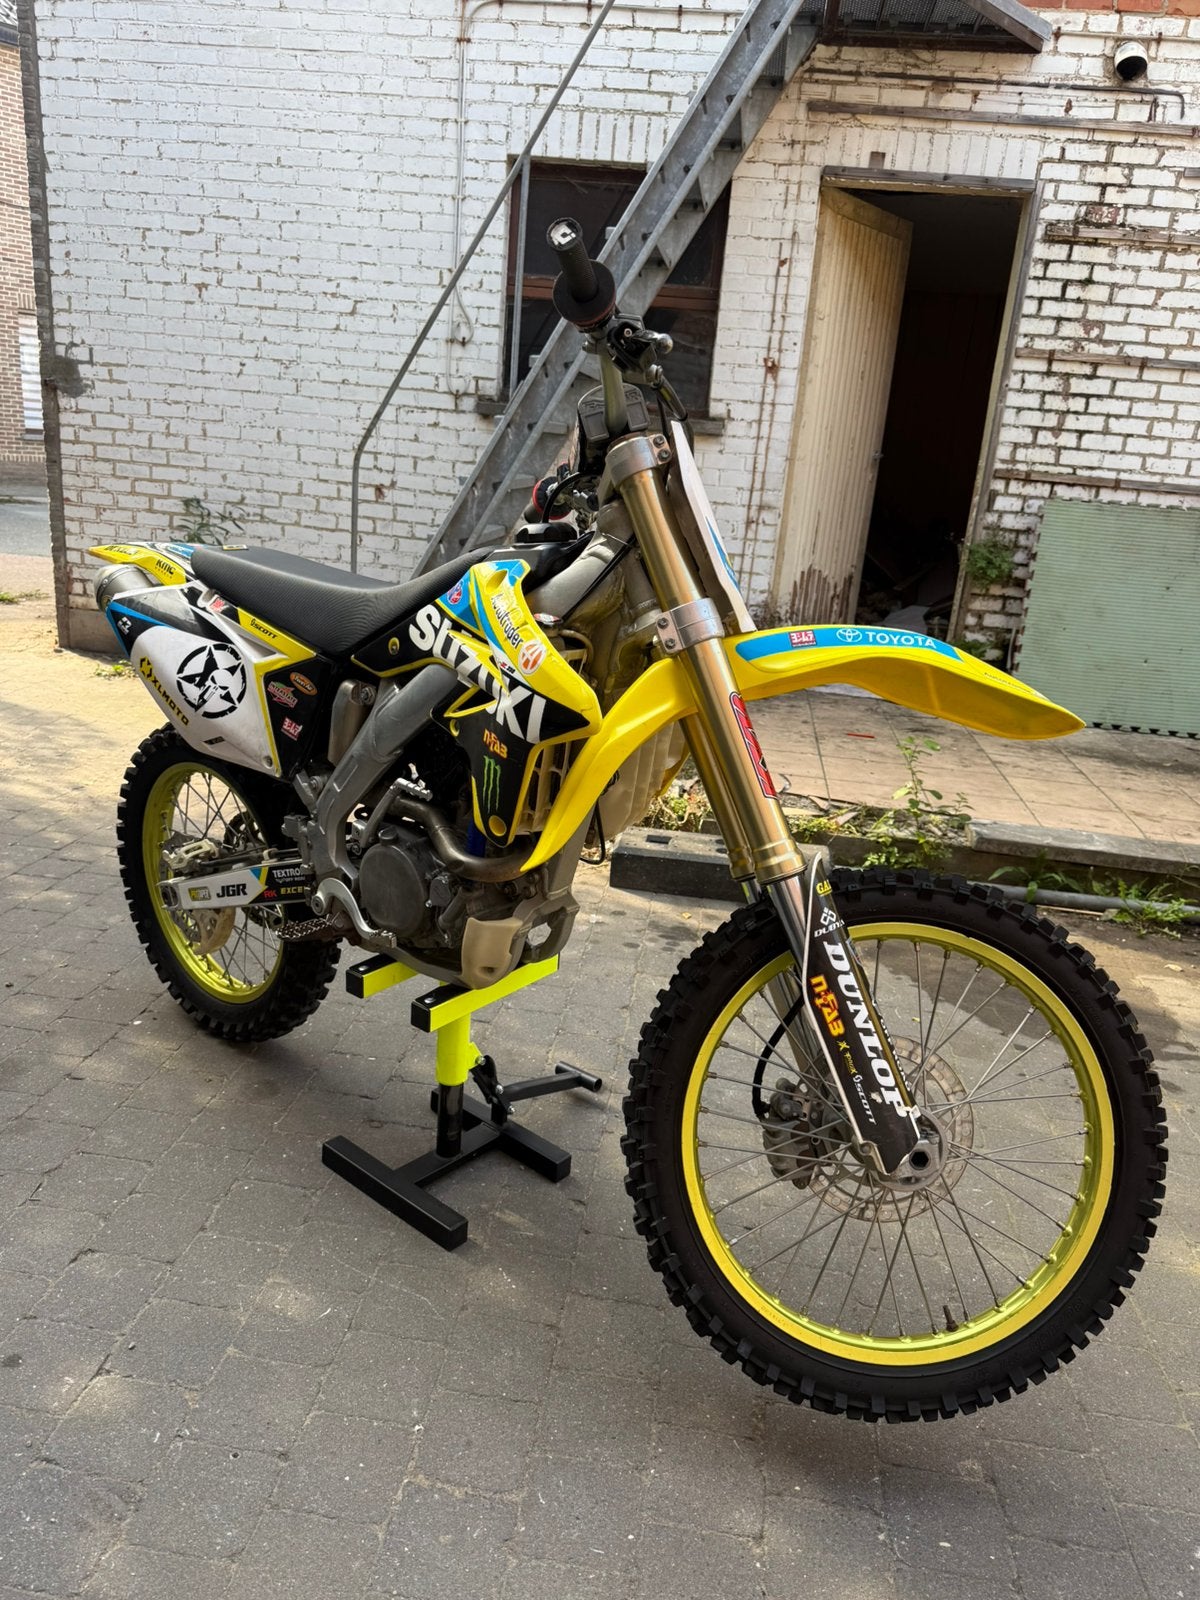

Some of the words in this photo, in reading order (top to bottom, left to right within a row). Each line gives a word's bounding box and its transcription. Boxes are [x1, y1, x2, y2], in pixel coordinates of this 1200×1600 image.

[254, 623, 278, 639] SCOTT
[865, 631, 937, 649] TOYOTA
[409, 604, 546, 744] SUZUKI
[152, 679, 190, 726] XLMOTO
[272, 867, 304, 879] TEXTRO
[216, 883, 248, 898] JGR
[264, 889, 278, 898] RK
[280, 885, 305, 895] EXCE
[823, 940, 909, 1118] DUNLOP
[854, 1083, 877, 1125] SCOTT
